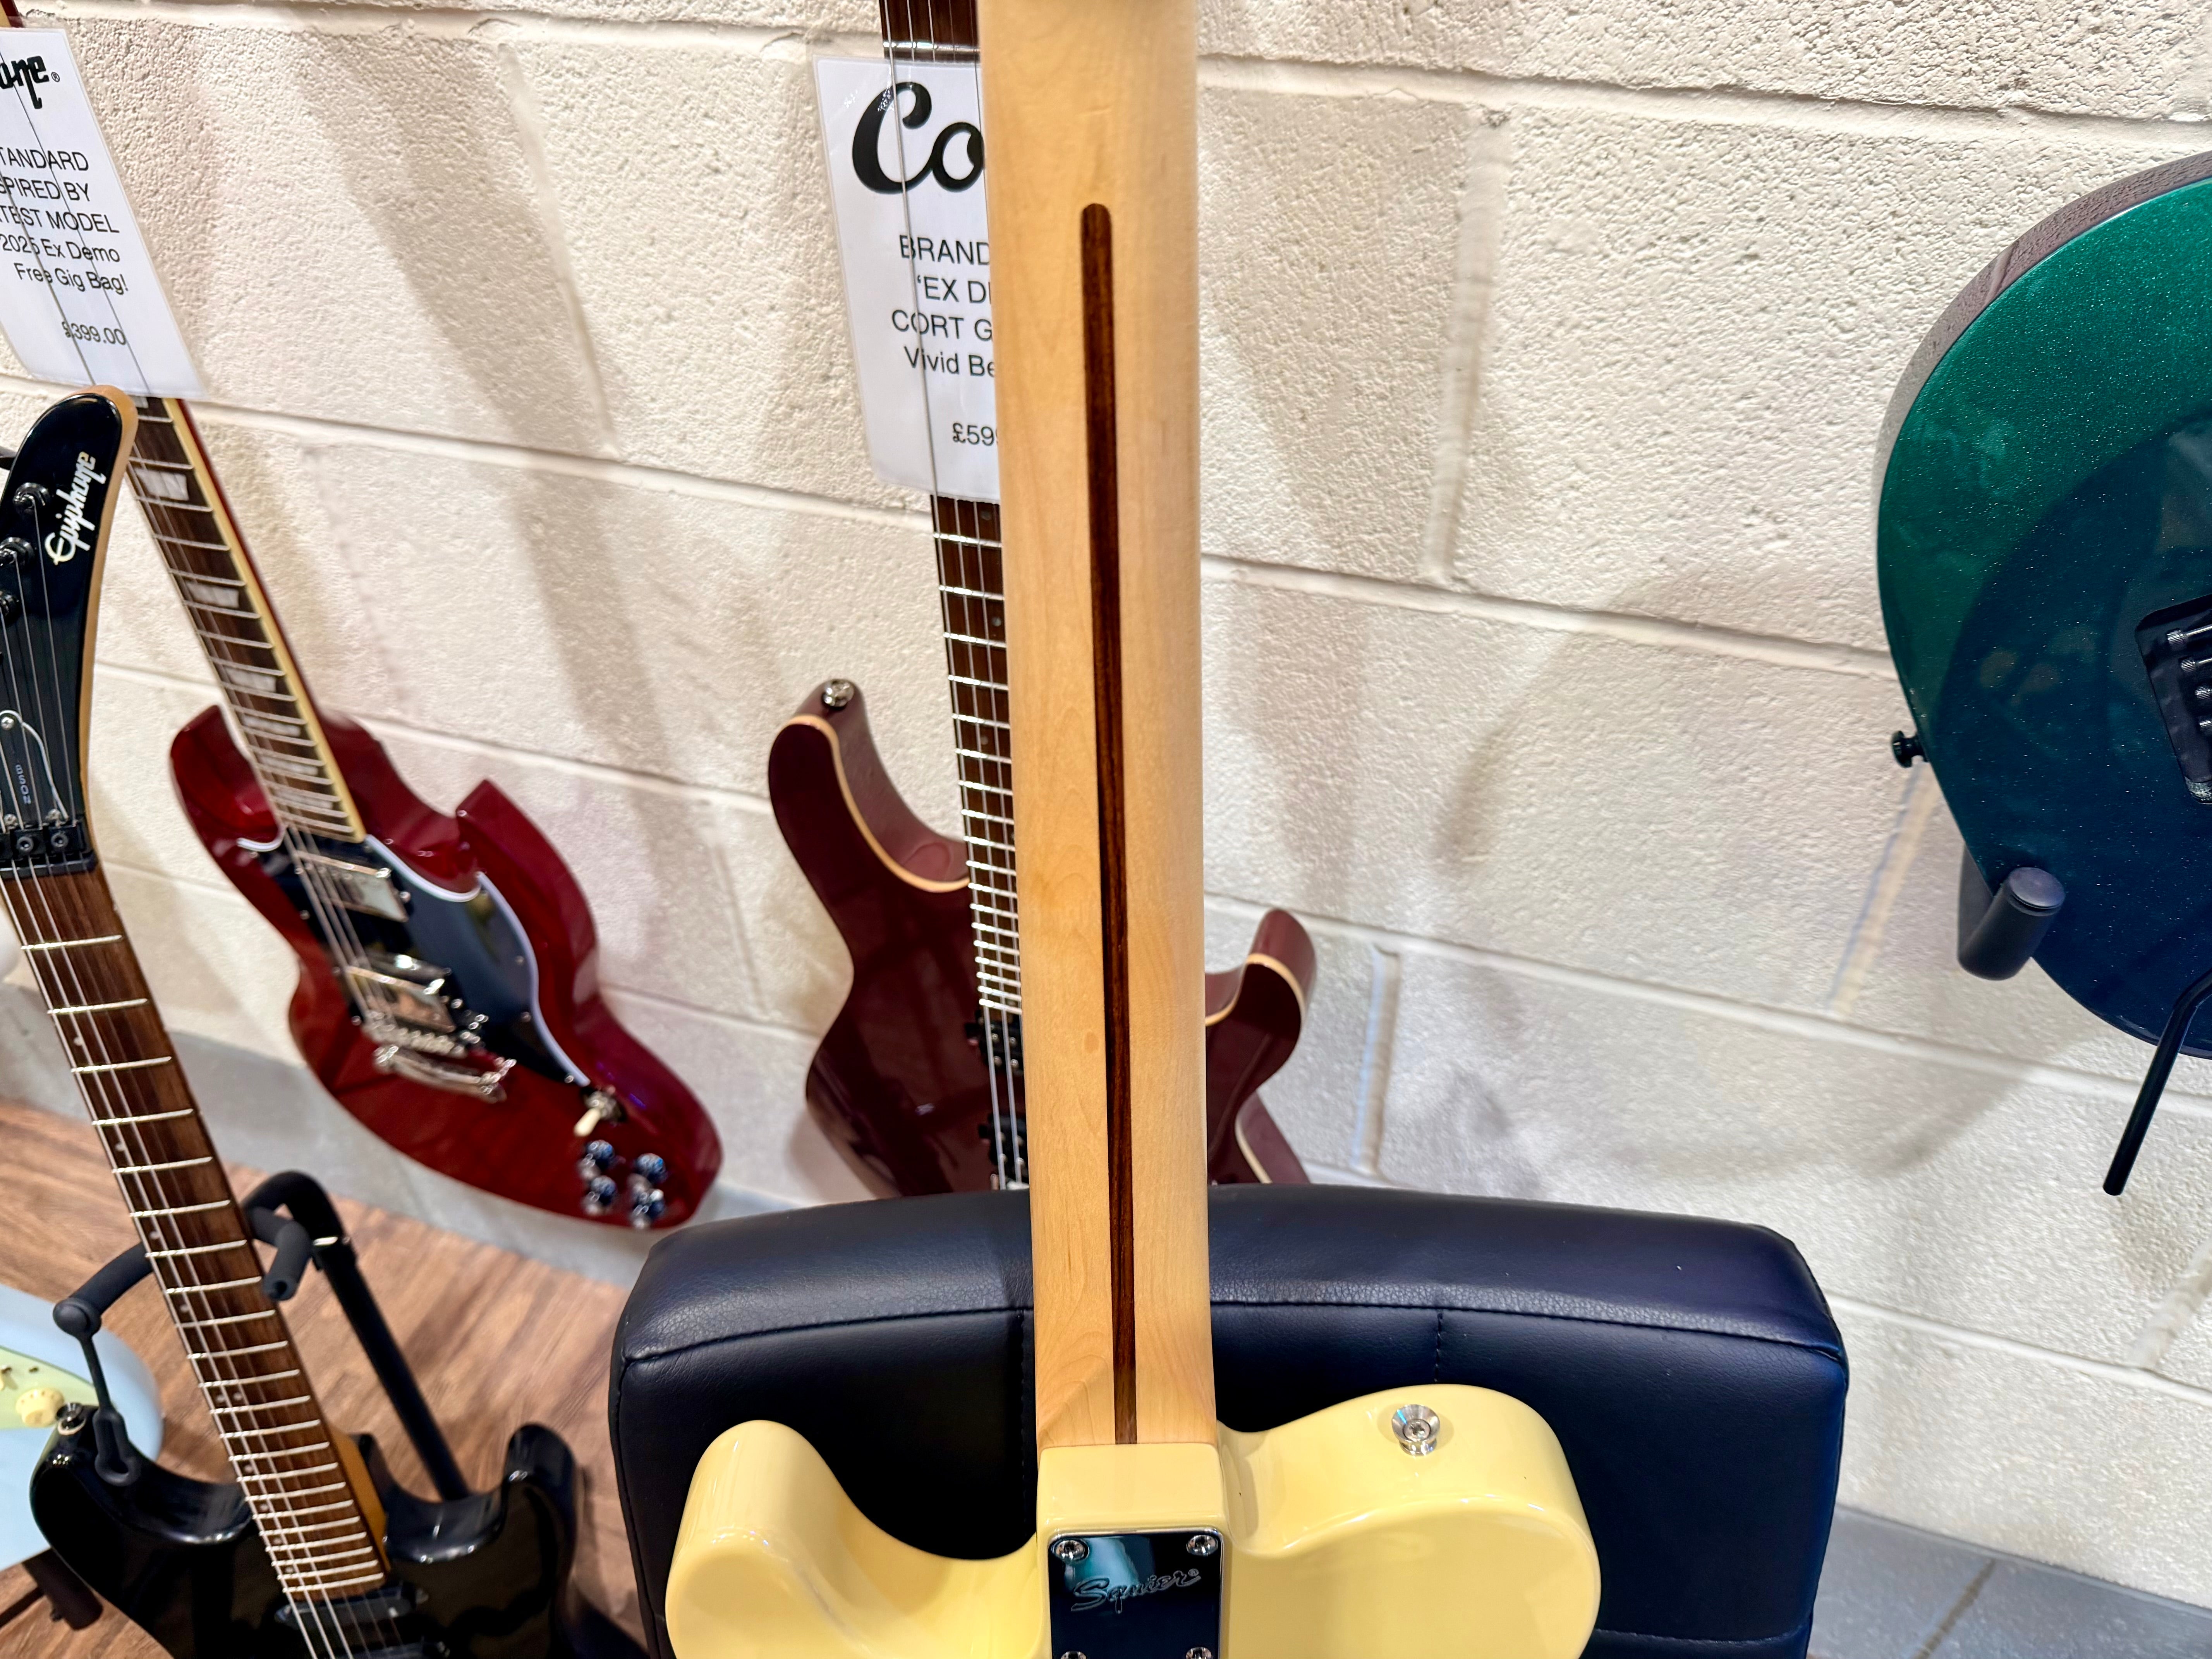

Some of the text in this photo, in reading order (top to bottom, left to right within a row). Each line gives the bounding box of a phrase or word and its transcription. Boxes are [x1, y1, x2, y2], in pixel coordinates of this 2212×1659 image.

[852, 82, 985, 194] Co
[63, 182, 90, 202] BY
[0, 205, 120, 234] TEST MODEL
[0, 234, 120, 263] 2025 Ex Demo
[900, 235, 990, 265] BRAND
[14, 263, 129, 295] Free Gig Bag!
[968, 281, 991, 304] D
[62, 321, 127, 345] £399.00
[892, 309, 993, 342] CORT G
[904, 346, 959, 374] Vivid
[952, 422, 998, 446] £59
[45, 452, 106, 565] Epiphone
[1071, 1568, 1202, 1614] Squier
